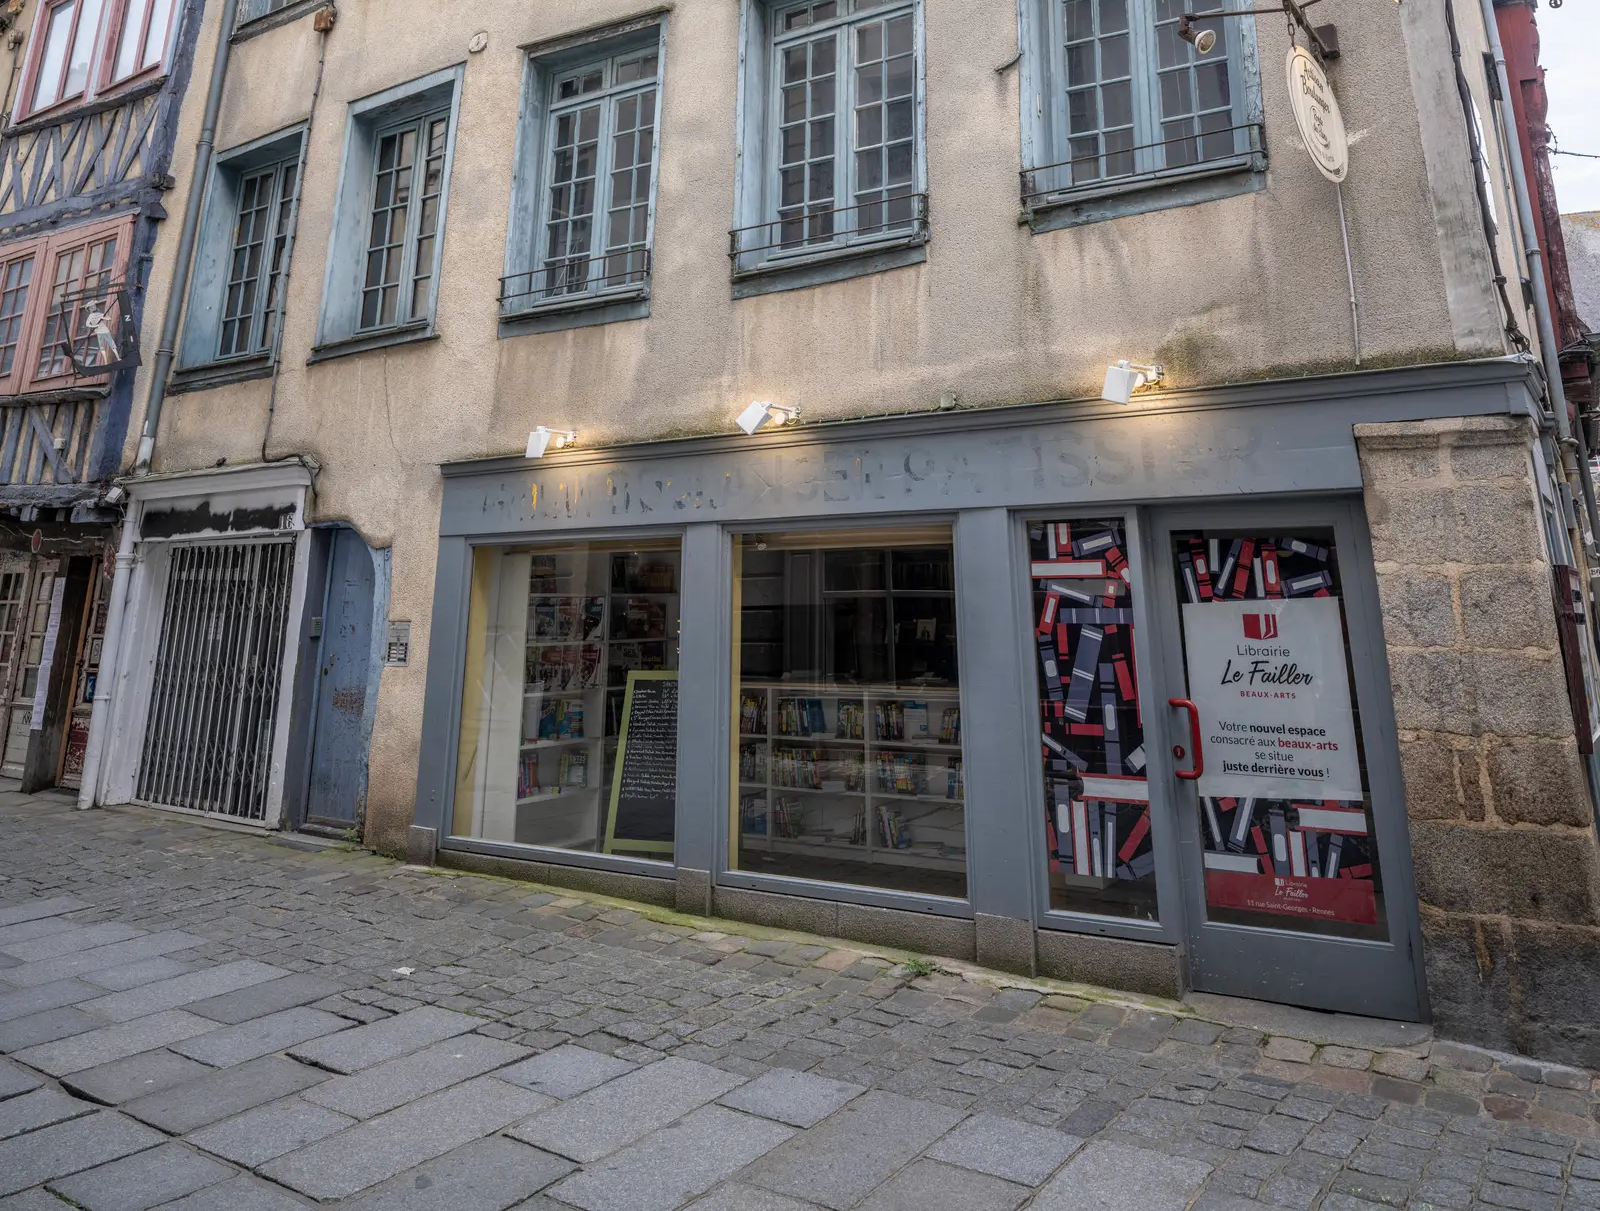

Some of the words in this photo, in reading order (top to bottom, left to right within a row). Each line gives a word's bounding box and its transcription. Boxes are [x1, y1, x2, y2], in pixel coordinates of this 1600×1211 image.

[1237, 645, 1290, 657] Librairie
[1221, 659, 1244, 685] Le
[1249, 660, 1313, 686] Failler
[1240, 690, 1296, 699] BEAUX-ARTS
[1218, 721, 1248, 732] Votre
[1249, 724, 1286, 735] nouvel
[1288, 726, 1326, 737] espace
[1210, 735, 1255, 746] consacré
[1257, 738, 1276, 747] aux
[1277, 737, 1339, 751] beaux-arts
[1254, 751, 1266, 760] se
[1268, 751, 1294, 761] situe
[1222, 760, 1249, 773] juste
[1251, 762, 1295, 775] derrière
[1297, 767, 1324, 777] vous
[1284, 880, 1308, 888] Librairie
[1274, 886, 1283, 896] Le
[1285, 887, 1309, 899] Failler
[1266, 902, 1308, 913] Saint-Georges
[1312, 906, 1335, 916] Rennes
